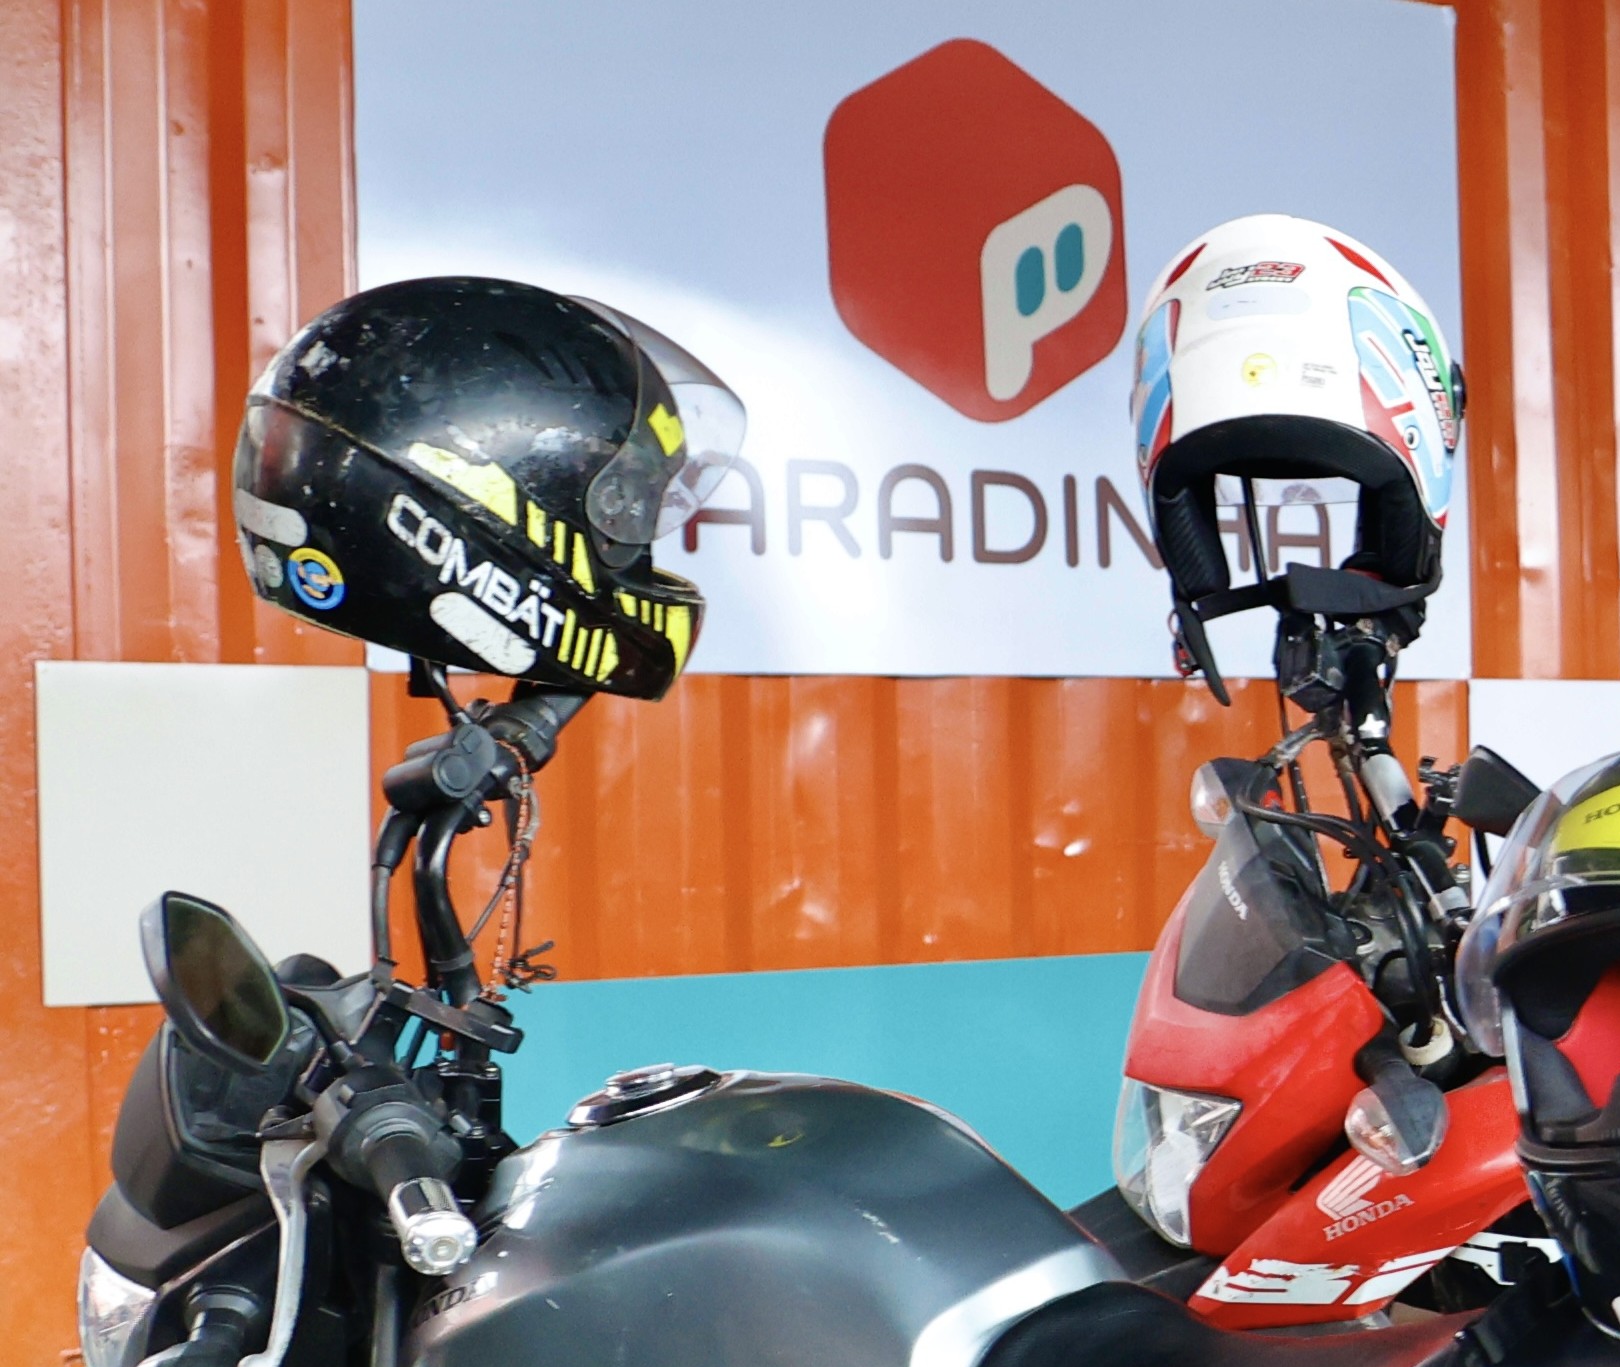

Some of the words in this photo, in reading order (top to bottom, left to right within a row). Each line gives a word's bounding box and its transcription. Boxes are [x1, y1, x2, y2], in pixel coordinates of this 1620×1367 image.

[683, 452, 1332, 571] ARADINHA
[1218, 860, 1249, 921] HONDA
[1322, 1193, 1416, 1242] HONDA
